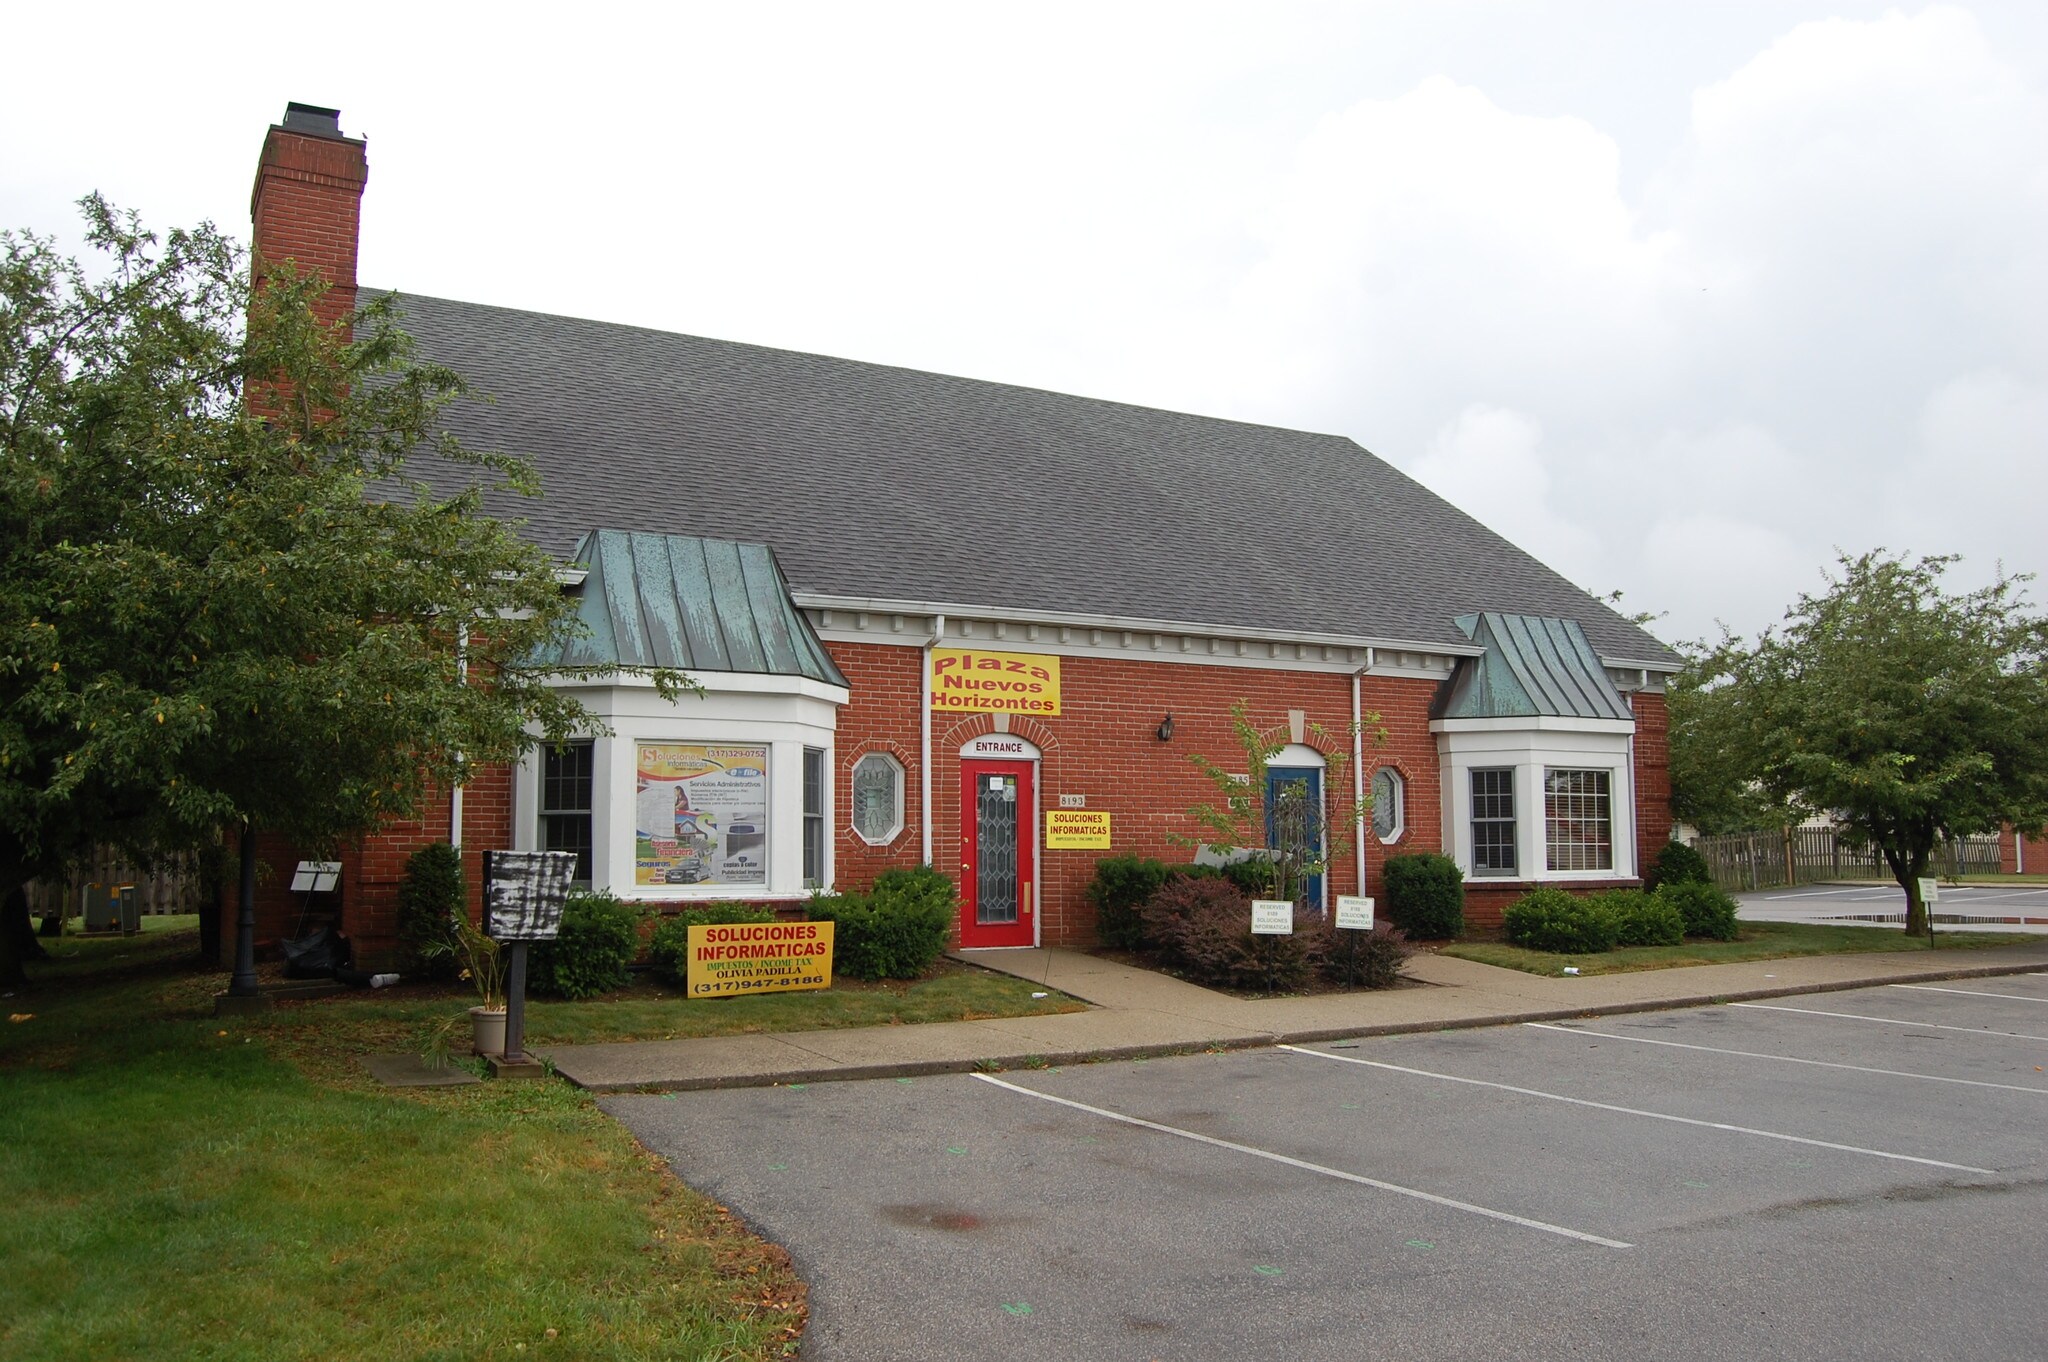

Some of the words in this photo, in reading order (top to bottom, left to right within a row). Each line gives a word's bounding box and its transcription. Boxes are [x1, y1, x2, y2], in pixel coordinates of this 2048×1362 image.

[934, 655, 1050, 682] Plaza
[943, 674, 1043, 693] Nuevos
[931, 692, 1054, 711] Horizontes
[976, 741, 1023, 753] ENTRANCE
[1230, 776, 1248, 784] 185
[1061, 797, 1083, 805] 8193
[1054, 814, 1103, 823] SOLUCIONES
[1050, 826, 1107, 835] INFORMATICAS
[706, 926, 817, 943] SOLUCIONES
[697, 942, 826, 961] INFORMATICAS
[707, 960, 753, 971] IMPUESTOS
[760, 958, 793, 968] INCOME
[795, 957, 813, 966] TAX
[716, 968, 753, 979] OLIVIA
[755, 966, 802, 976] PADILLA
[694, 975, 824, 994] (317)947-8186
